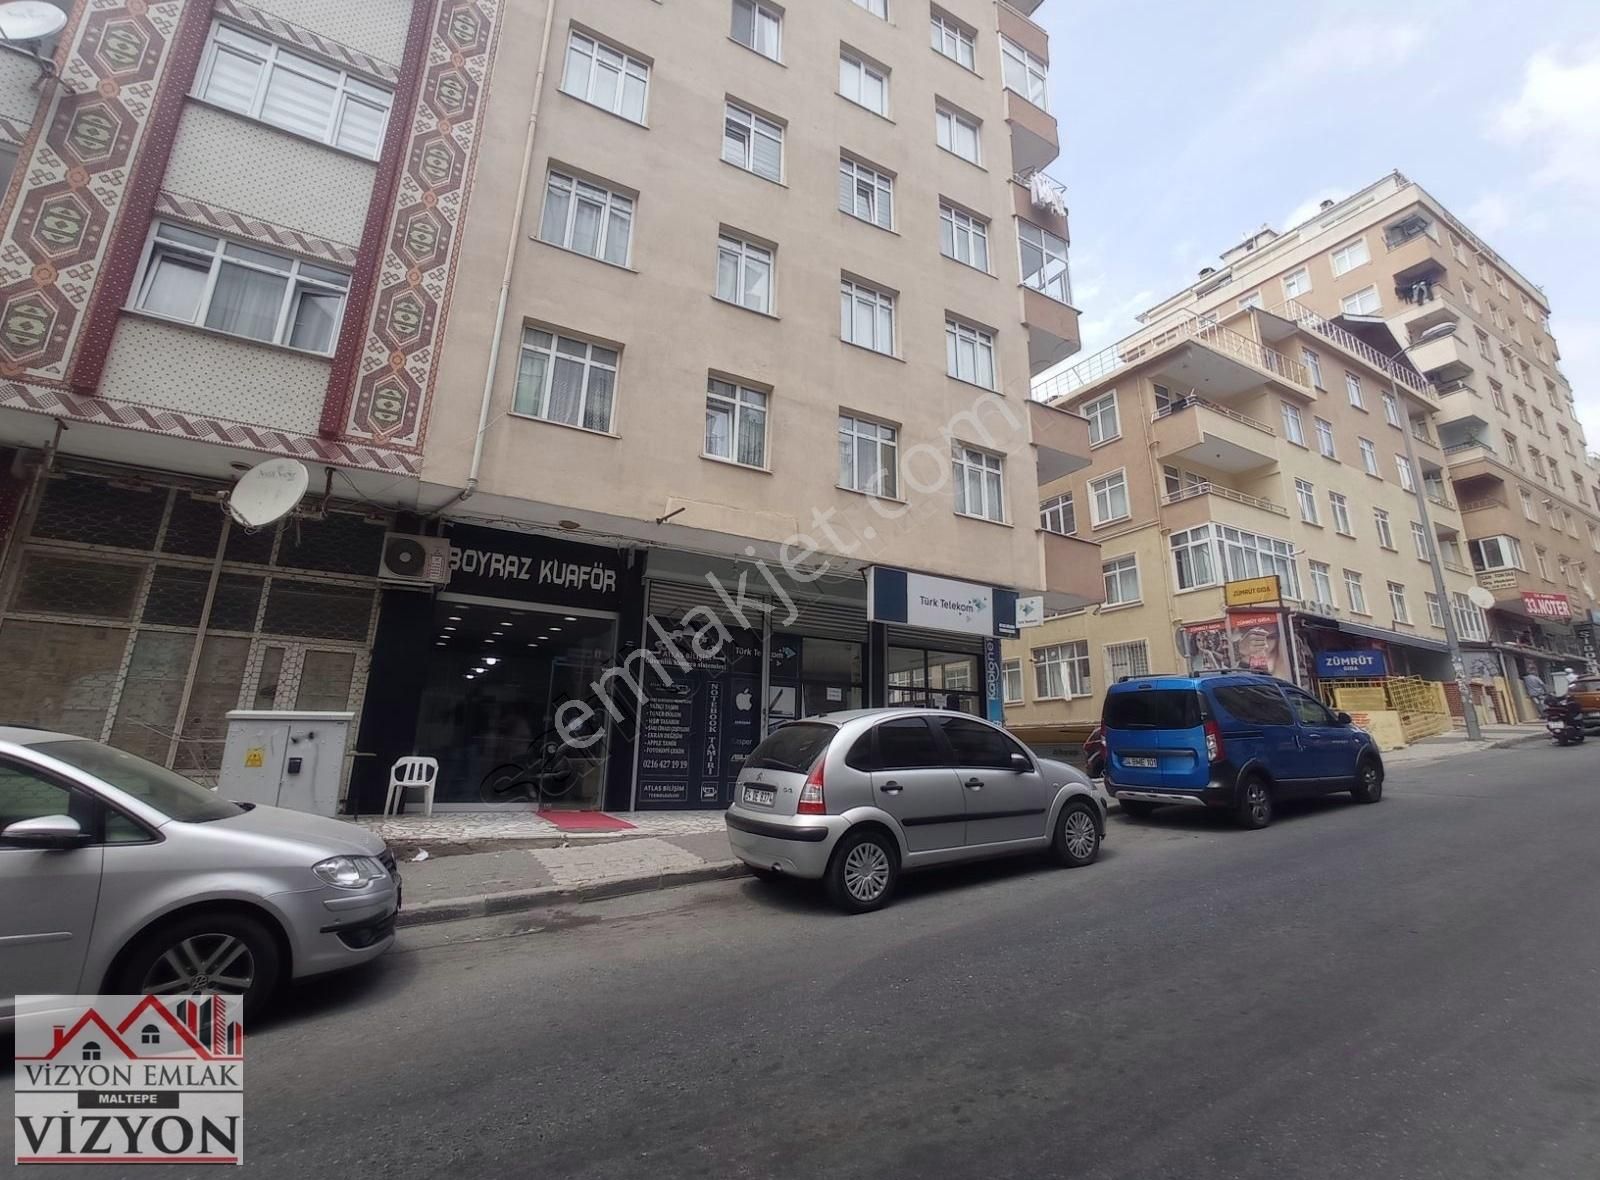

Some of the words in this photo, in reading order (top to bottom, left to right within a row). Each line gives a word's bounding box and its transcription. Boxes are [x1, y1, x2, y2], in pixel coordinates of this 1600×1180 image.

[449, 547, 533, 581] BOYRAZ
[538, 558, 617, 594] KUAFÖR
[919, 595, 938, 608] Türk
[940, 599, 974, 613] Telekom
[1326, 655, 1374, 666] ZÜMRÜT
[709, 684, 719, 732] NOTEBOOK
[643, 759, 659, 768] 0216
[660, 760, 671, 768] 427
[644, 784, 662, 792] ATLAS
